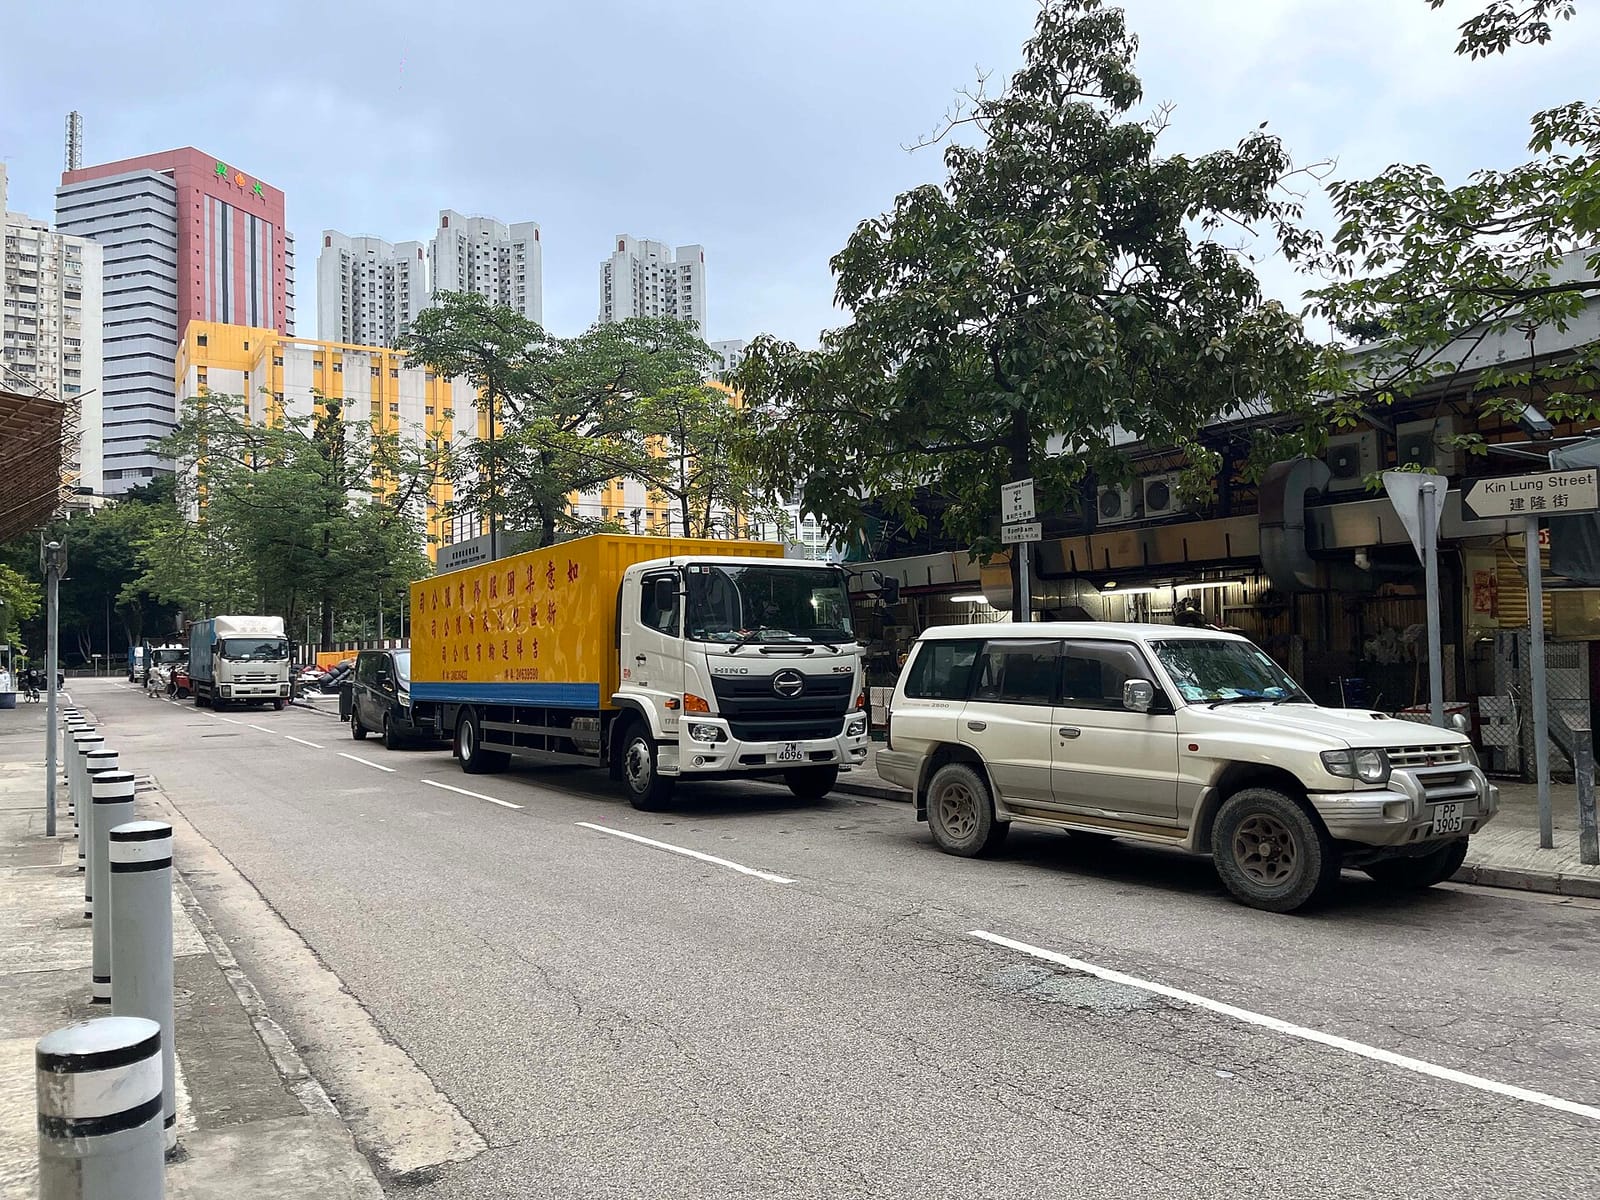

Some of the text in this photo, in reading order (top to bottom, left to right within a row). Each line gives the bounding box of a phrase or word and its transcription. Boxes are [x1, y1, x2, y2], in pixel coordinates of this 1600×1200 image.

[1485, 473, 1593, 494] Kin Lung Street
[1509, 493, 1569, 512] 建隆街
[714, 666, 749, 675] HINO
[784, 743, 797, 752] ZW
[778, 750, 803, 761] 4096
[1443, 804, 1456, 818] PP
[1436, 817, 1460, 832] 3905
